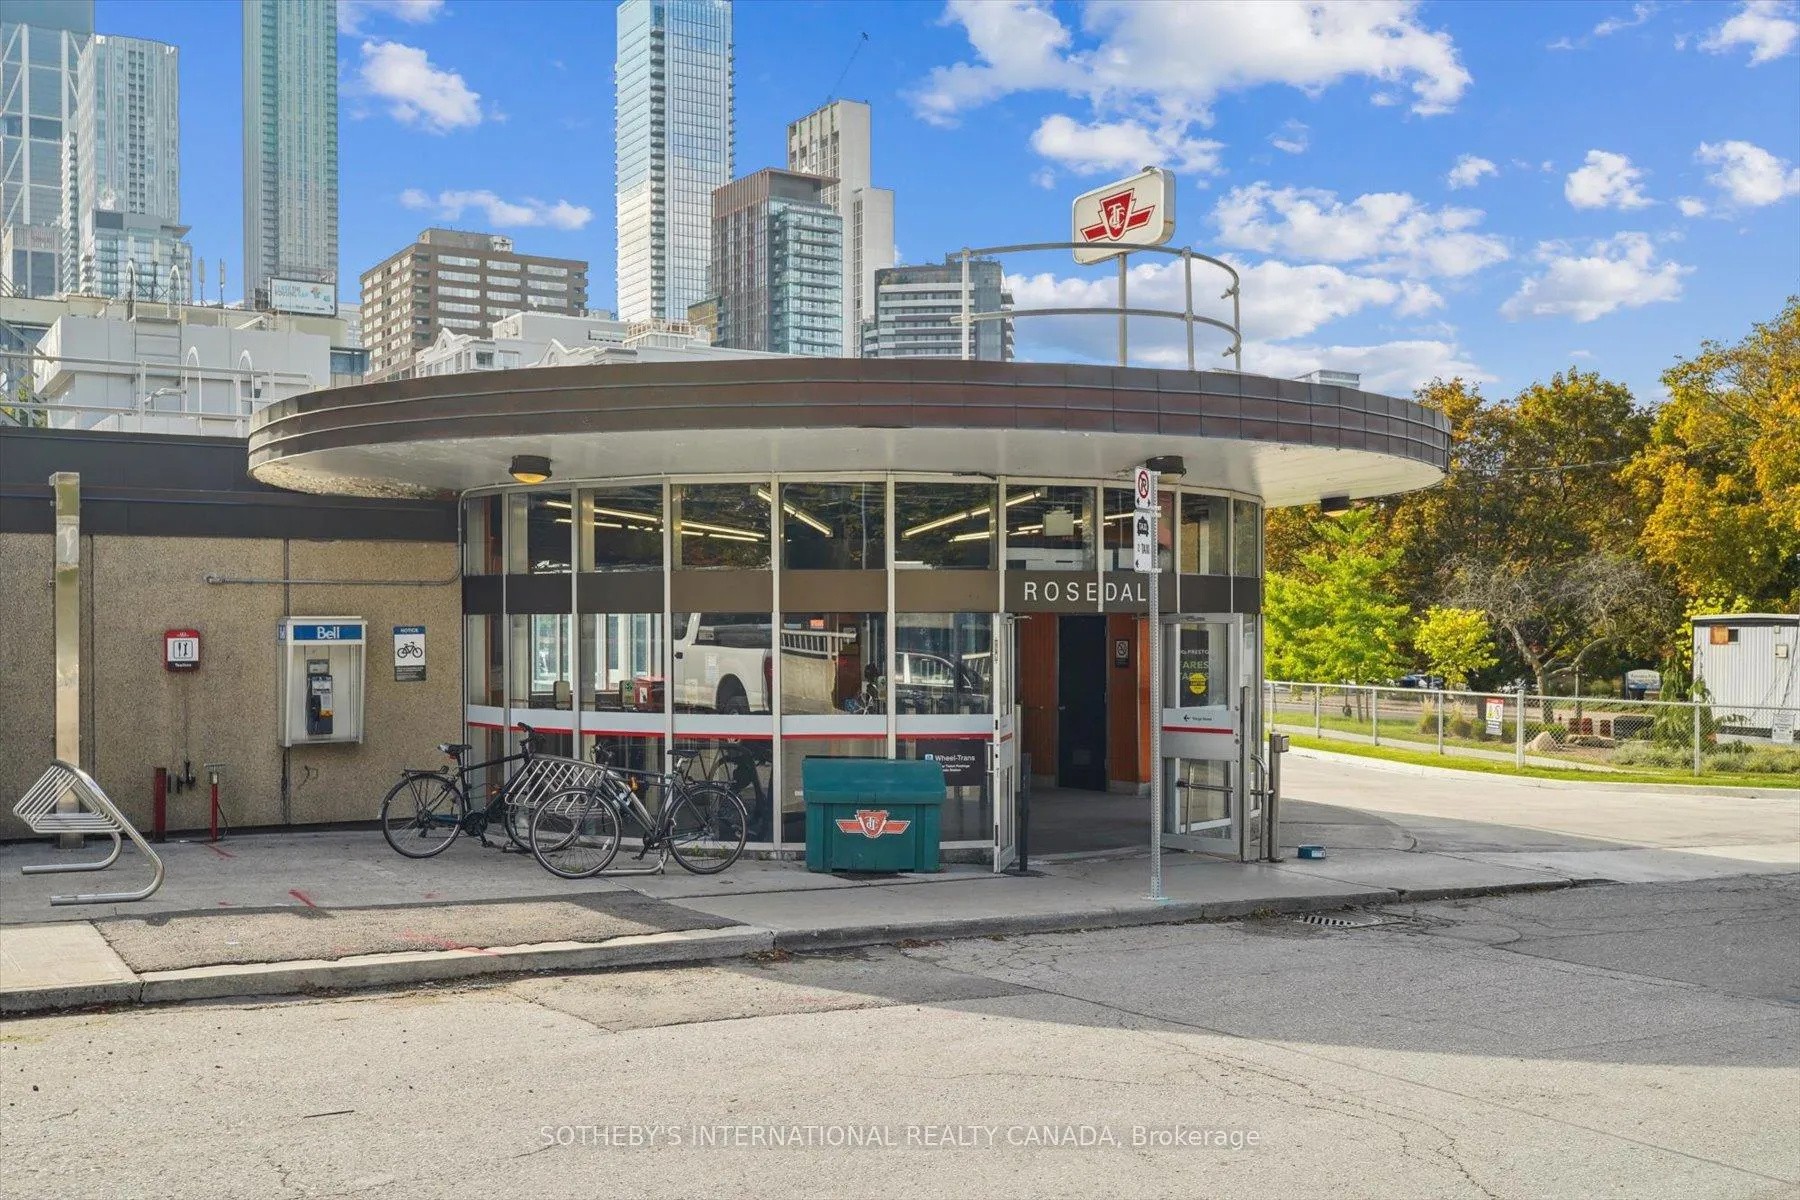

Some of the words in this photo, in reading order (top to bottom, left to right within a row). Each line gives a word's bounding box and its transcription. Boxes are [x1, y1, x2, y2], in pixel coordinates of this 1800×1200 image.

[1024, 581, 1147, 602] ROSEDAL
[317, 626, 340, 640] Bell
[934, 754, 976, 762] Wheel-Trans
